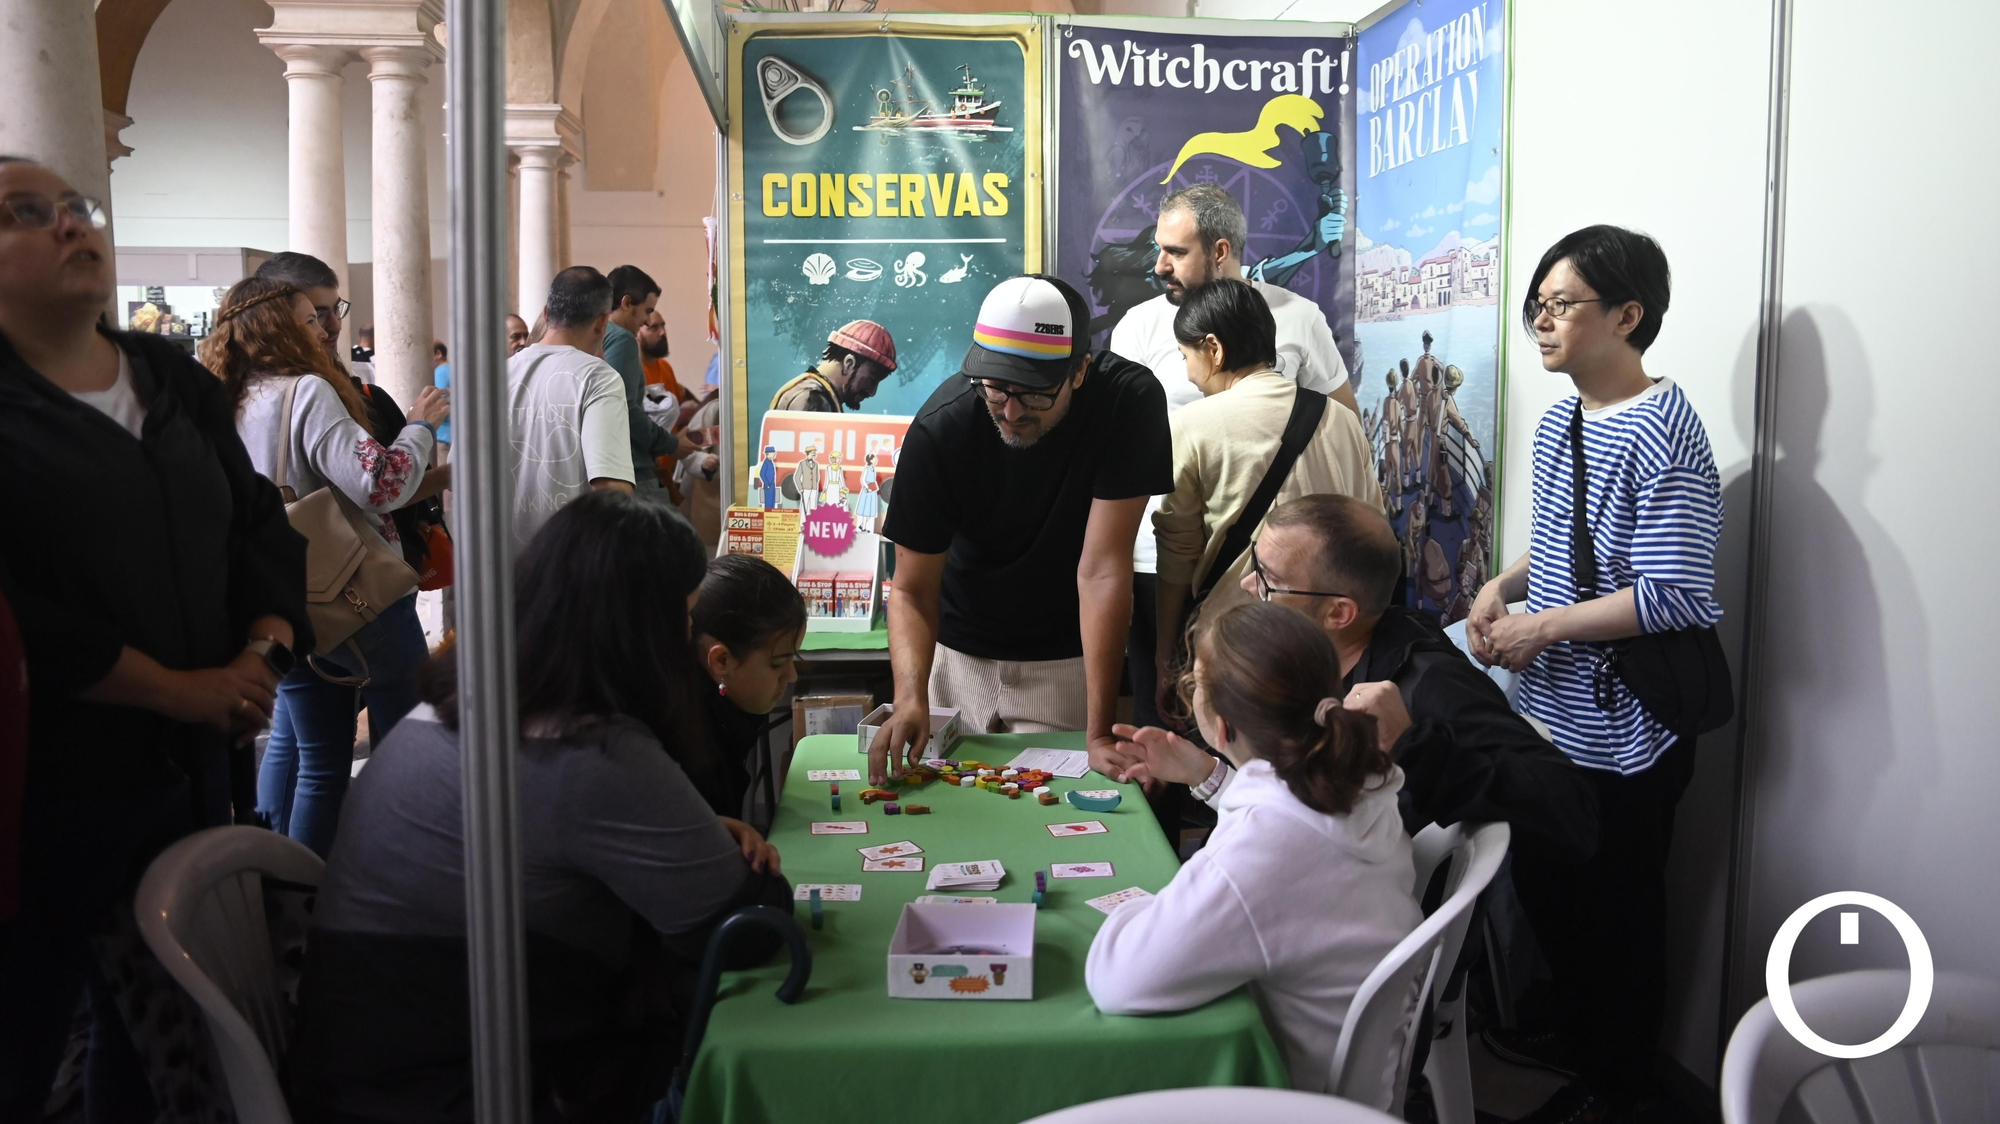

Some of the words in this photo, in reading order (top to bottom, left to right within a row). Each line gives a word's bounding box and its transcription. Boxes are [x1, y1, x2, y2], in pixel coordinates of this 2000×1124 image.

[1068, 38, 1350, 99] Witchcraft!
[1370, 2, 1488, 113] OPERATION
[1369, 67, 1483, 178] BARCLAY
[762, 172, 1009, 217] CONSERVAS
[809, 521, 848, 539] NEW
[419, 567, 437, 582] ING
